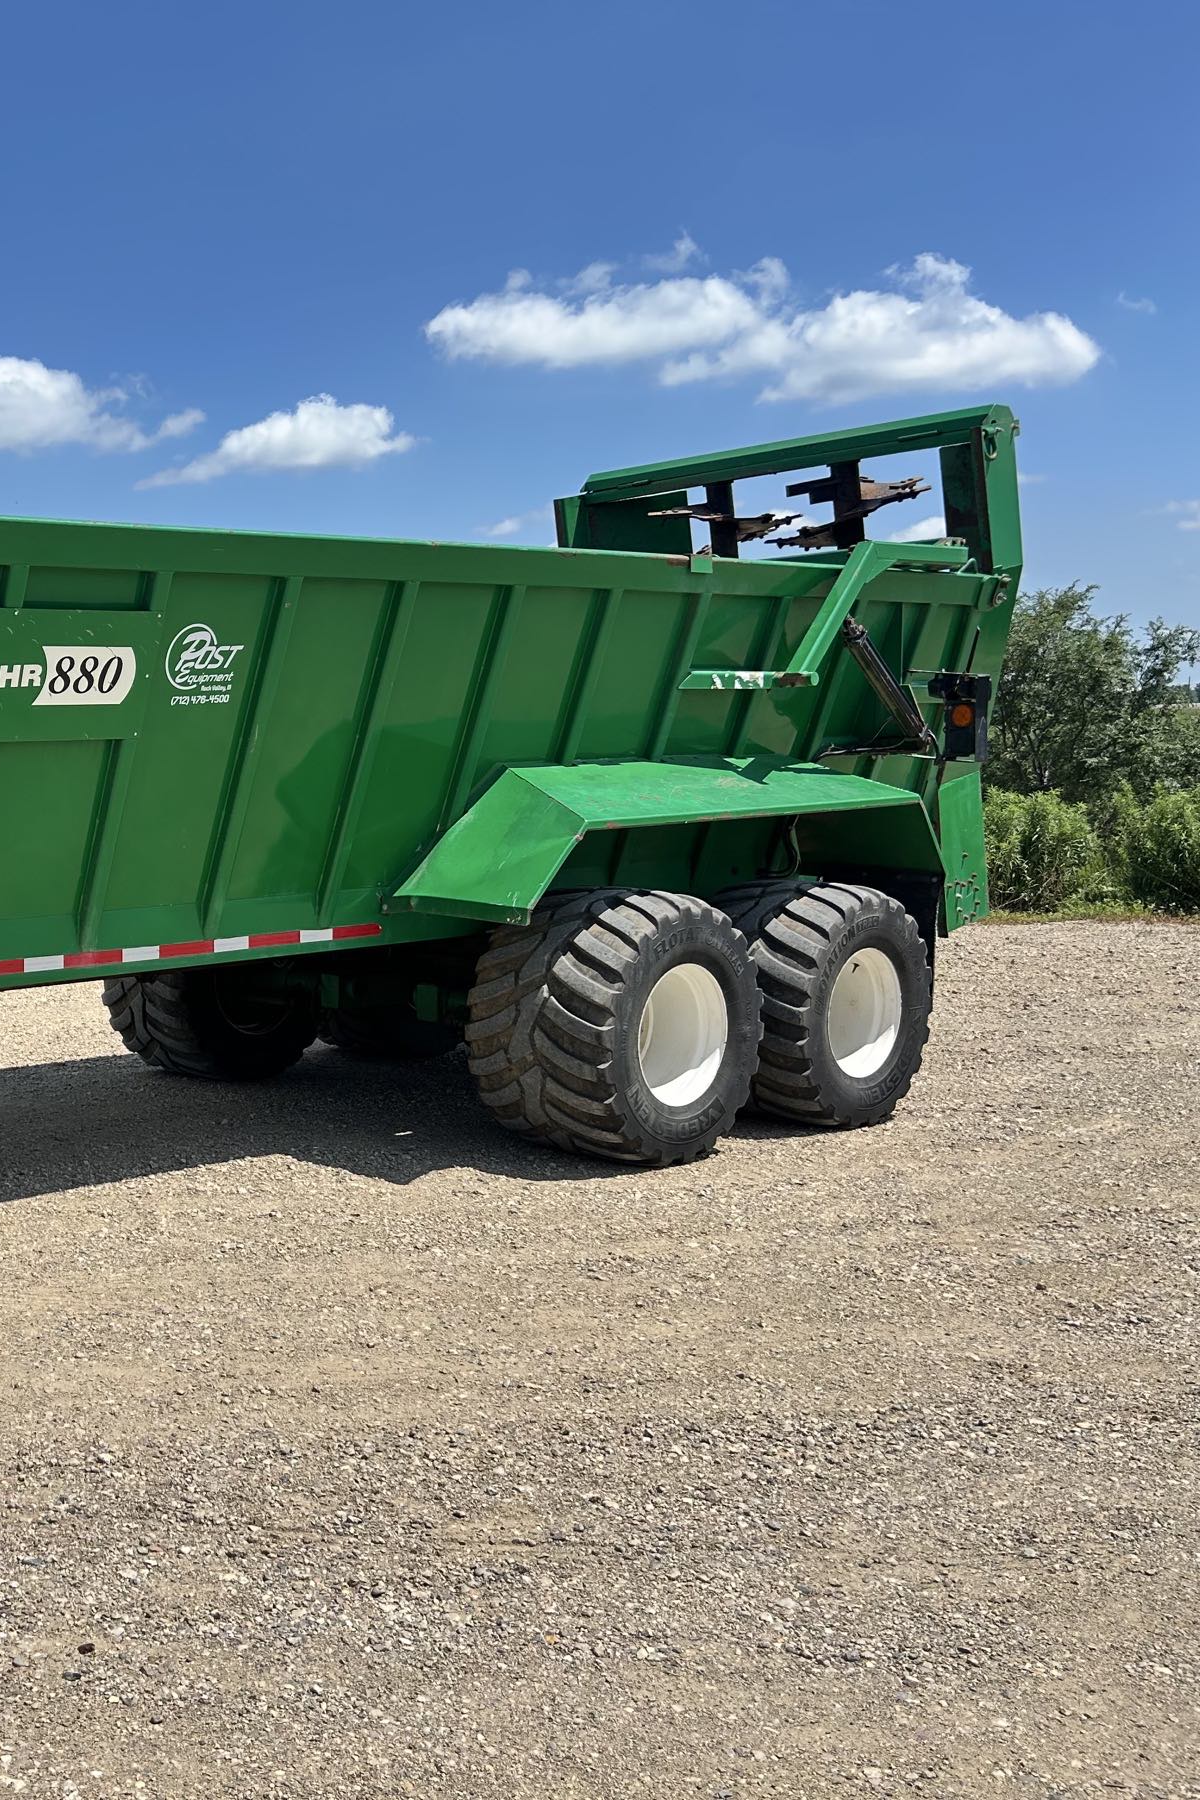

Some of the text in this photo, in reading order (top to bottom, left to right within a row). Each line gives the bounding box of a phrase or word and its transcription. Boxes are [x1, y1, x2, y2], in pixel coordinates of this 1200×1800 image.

[48, 655, 123, 694] 880
[175, 662, 234, 685] Equipment
[171, 694, 230, 706] (712) 476-4500
